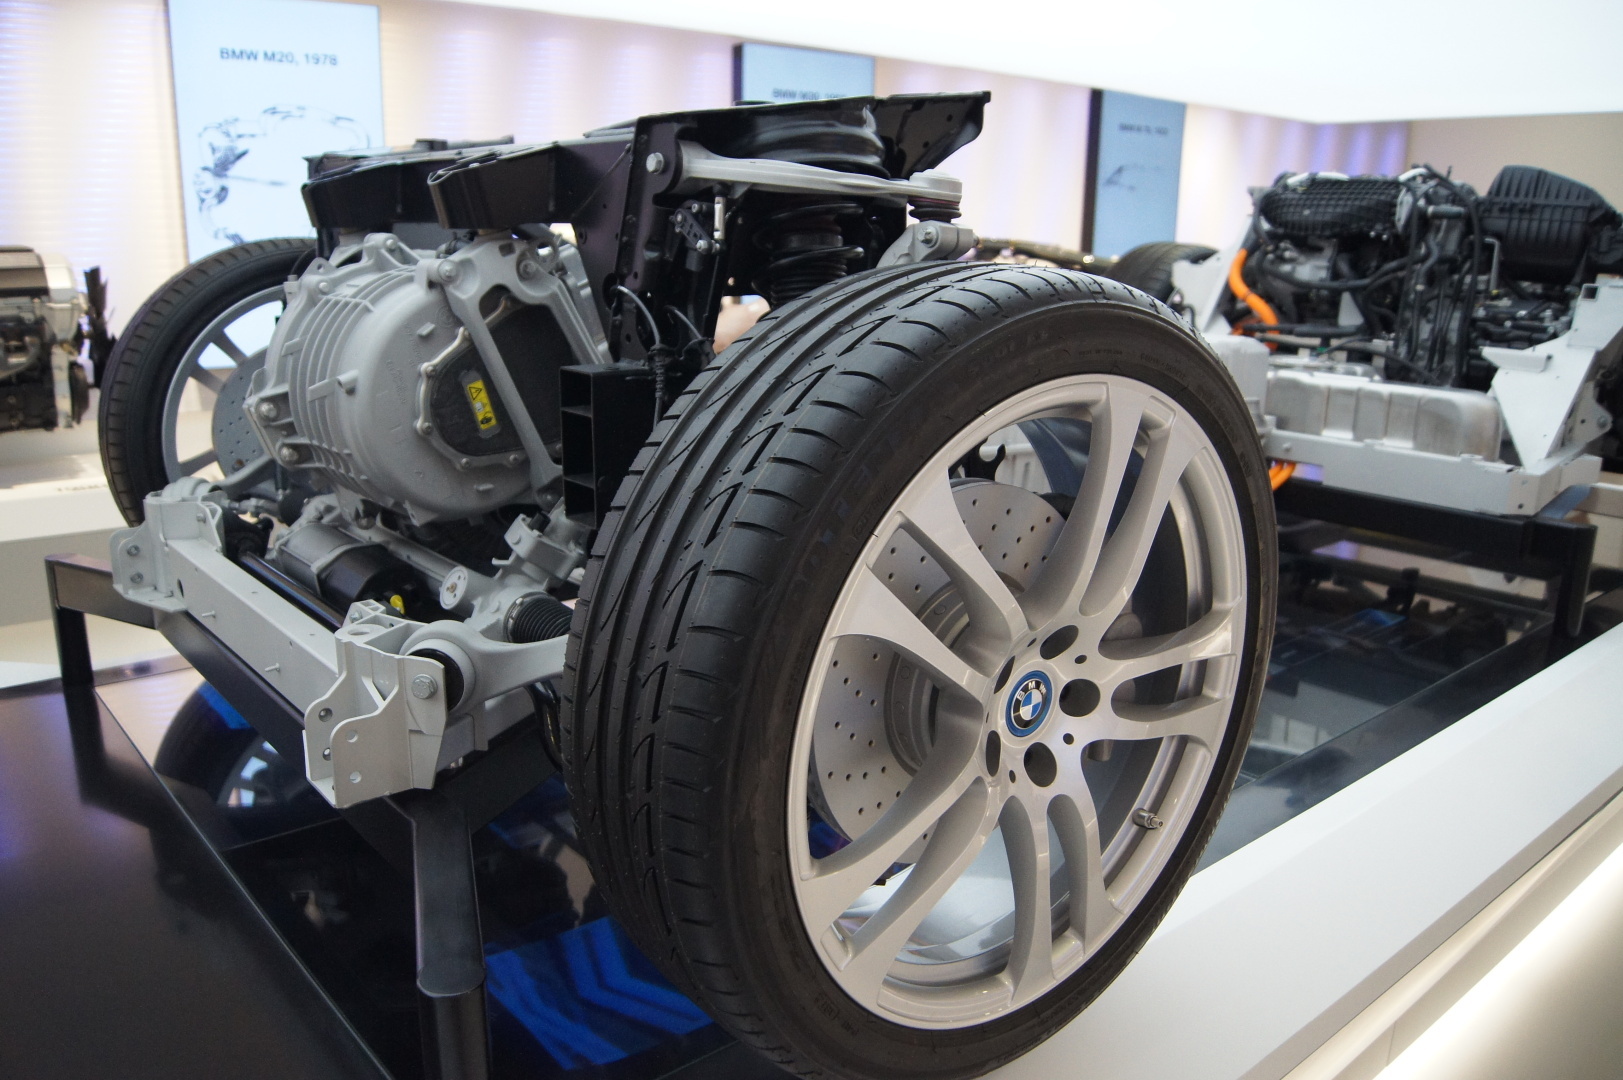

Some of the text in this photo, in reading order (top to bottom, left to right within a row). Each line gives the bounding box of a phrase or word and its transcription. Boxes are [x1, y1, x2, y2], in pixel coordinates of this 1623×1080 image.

[219, 47, 338, 66] BMW M20, 1978
[772, 87, 797, 99] BMW
